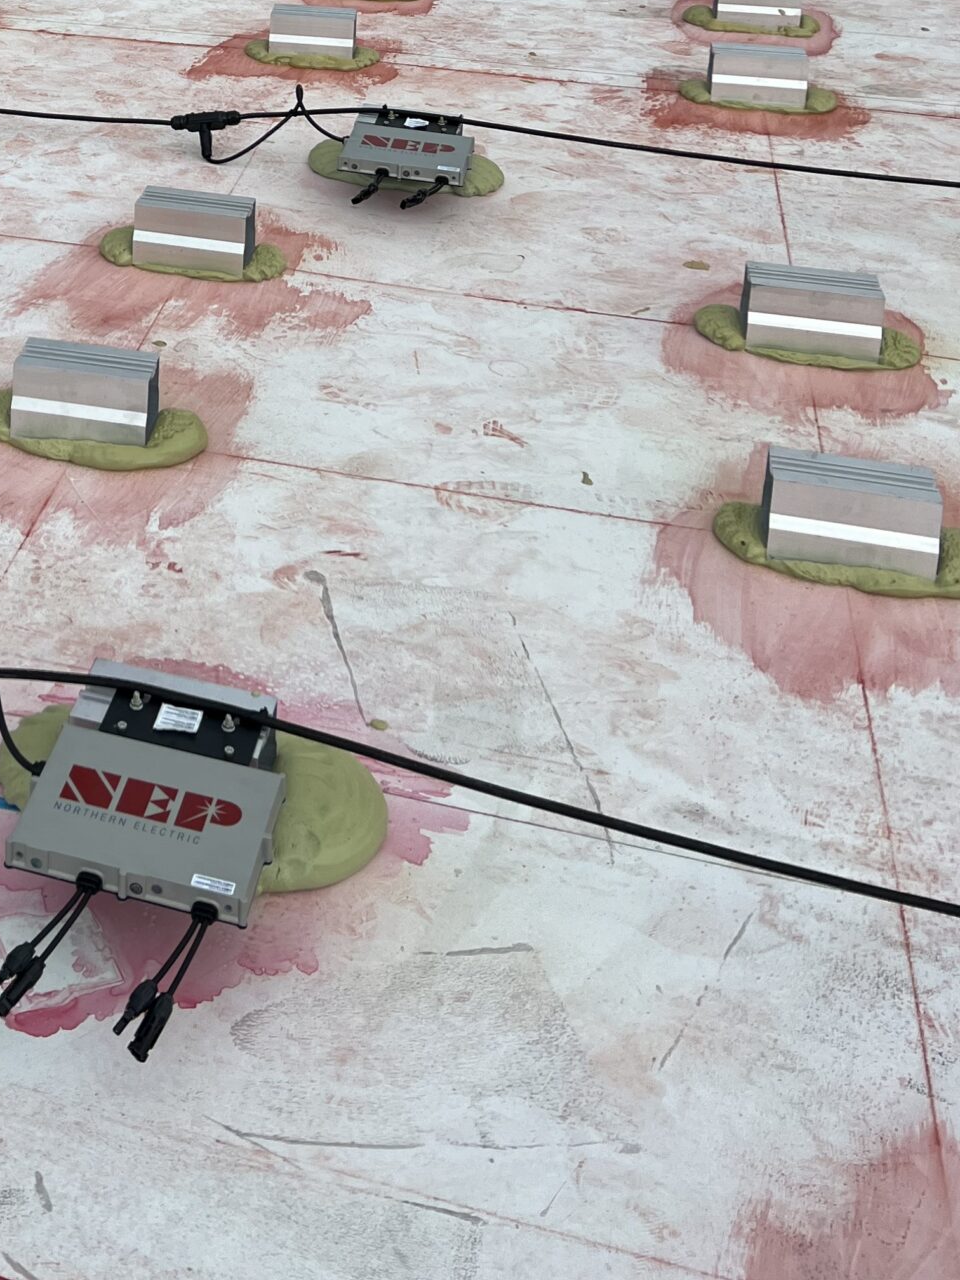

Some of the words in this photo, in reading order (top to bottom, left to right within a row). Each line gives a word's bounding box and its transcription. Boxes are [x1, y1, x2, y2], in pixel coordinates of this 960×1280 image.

[361, 134, 455, 154] NEP
[59, 763, 243, 832] NEP
[53, 801, 128, 828] NORTHERN
[133, 821, 202, 846] ELECTRIC
